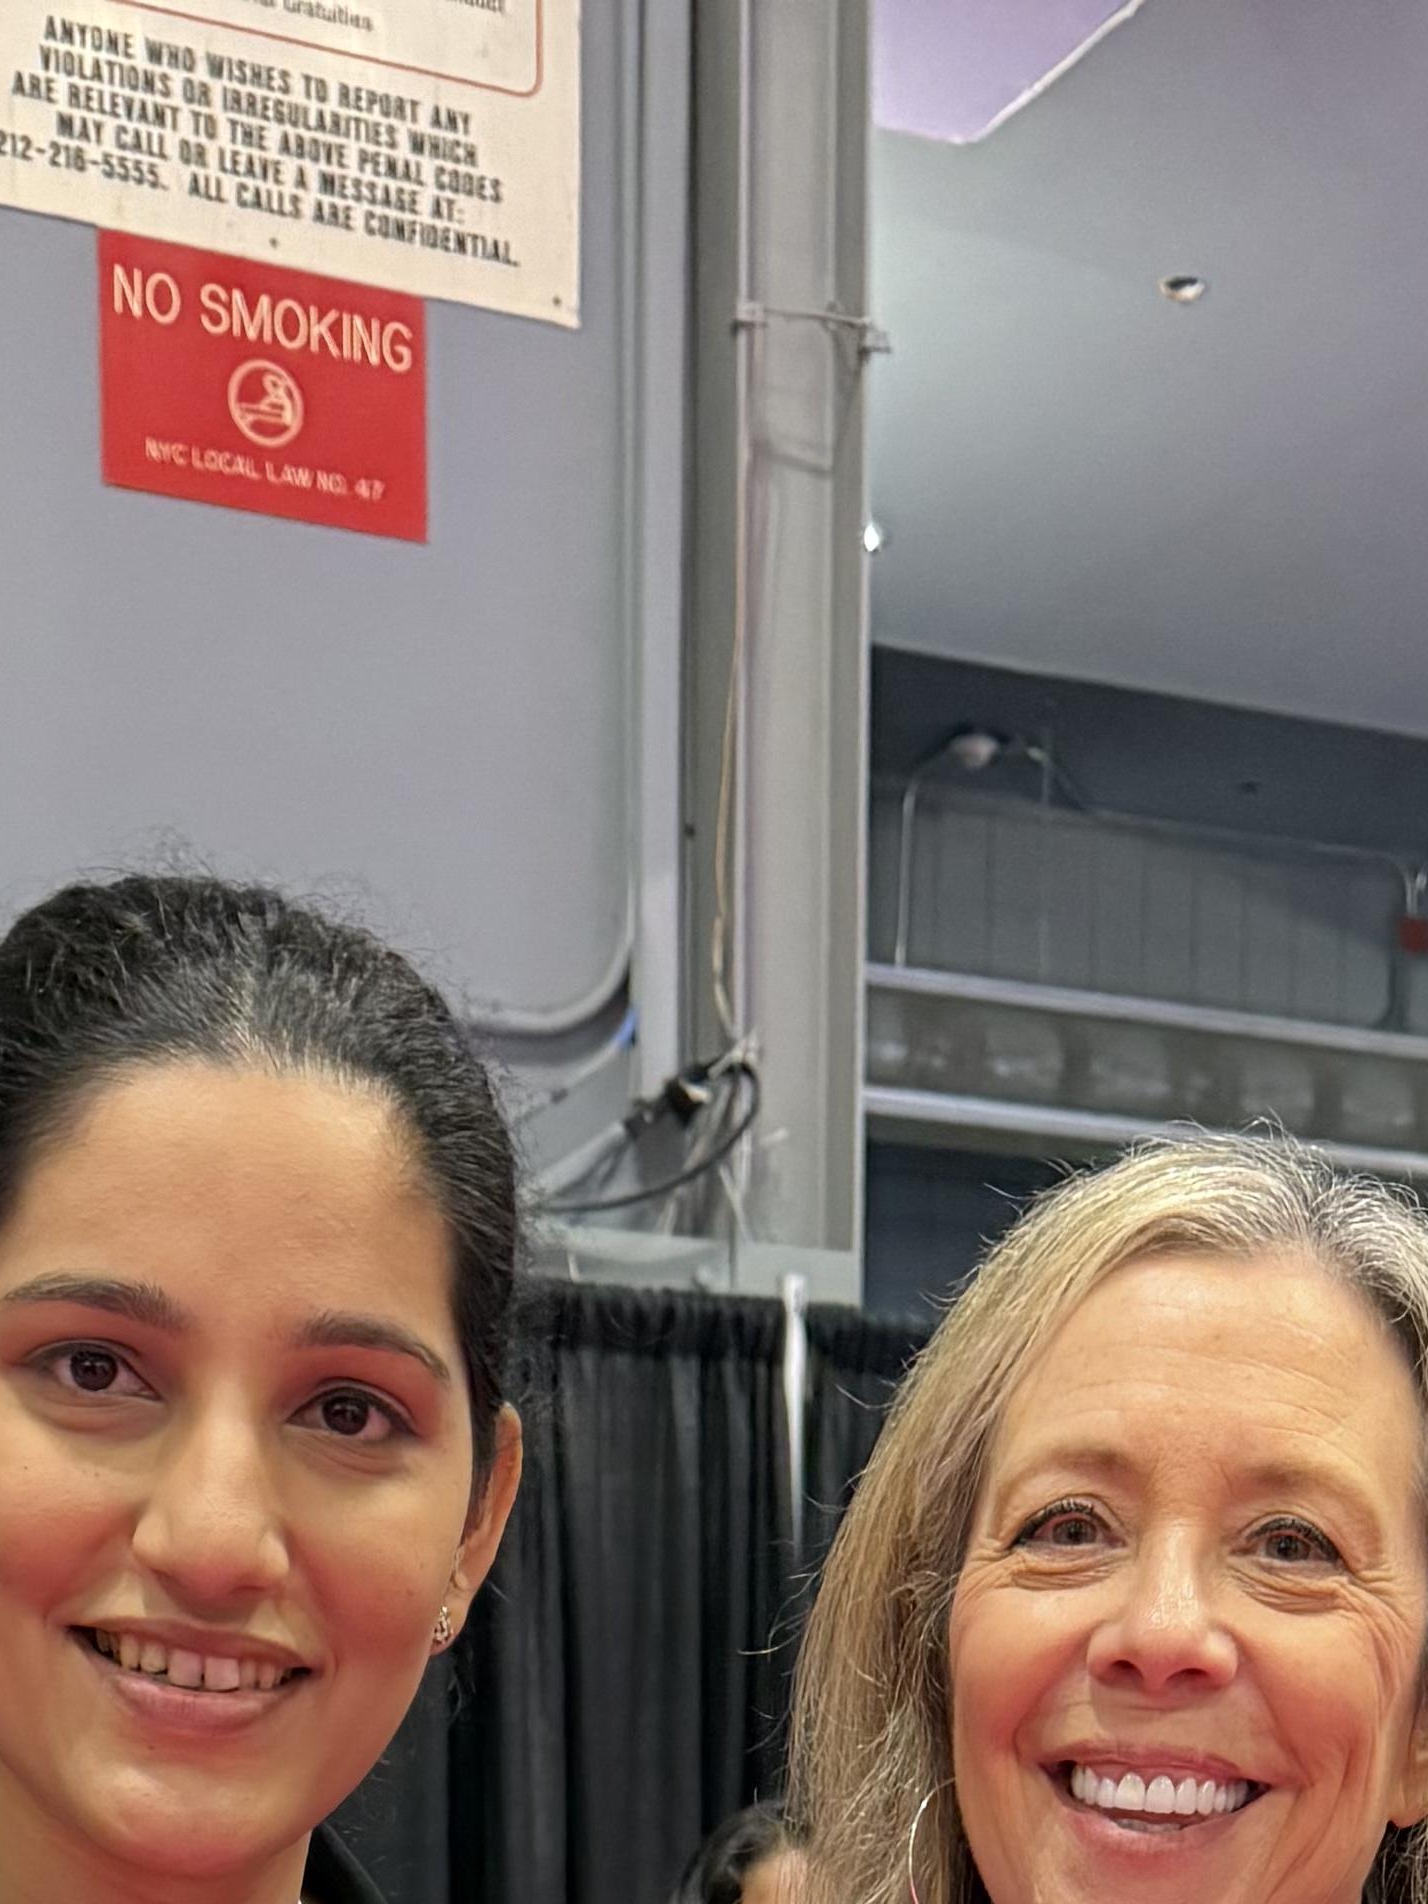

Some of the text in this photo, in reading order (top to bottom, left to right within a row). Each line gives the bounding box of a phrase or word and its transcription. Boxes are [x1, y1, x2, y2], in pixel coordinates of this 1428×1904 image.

[39, 44, 478, 167] VIOLATIONS OR IRREGULARITIES WHICH
[44, 15, 473, 135] ANYONE WHO WISHES TO REPORT ANY
[12, 70, 503, 203] ARE RELEVANT TO THE ABOVE PENAL CODES
[56, 111, 465, 225] MAY CALL OR LEAVE A MESSAGE AT:
[187, 173, 227, 203] ALL
[236, 182, 302, 220] CALLS
[312, 201, 354, 231] ARE
[364, 211, 520, 267] CONFIDENTIAL.
[113, 263, 413, 374] NO SMOKING
[144, 436, 188, 465] NYC
[191, 447, 261, 480] LOCAL
[265, 462, 313, 489] LAW
